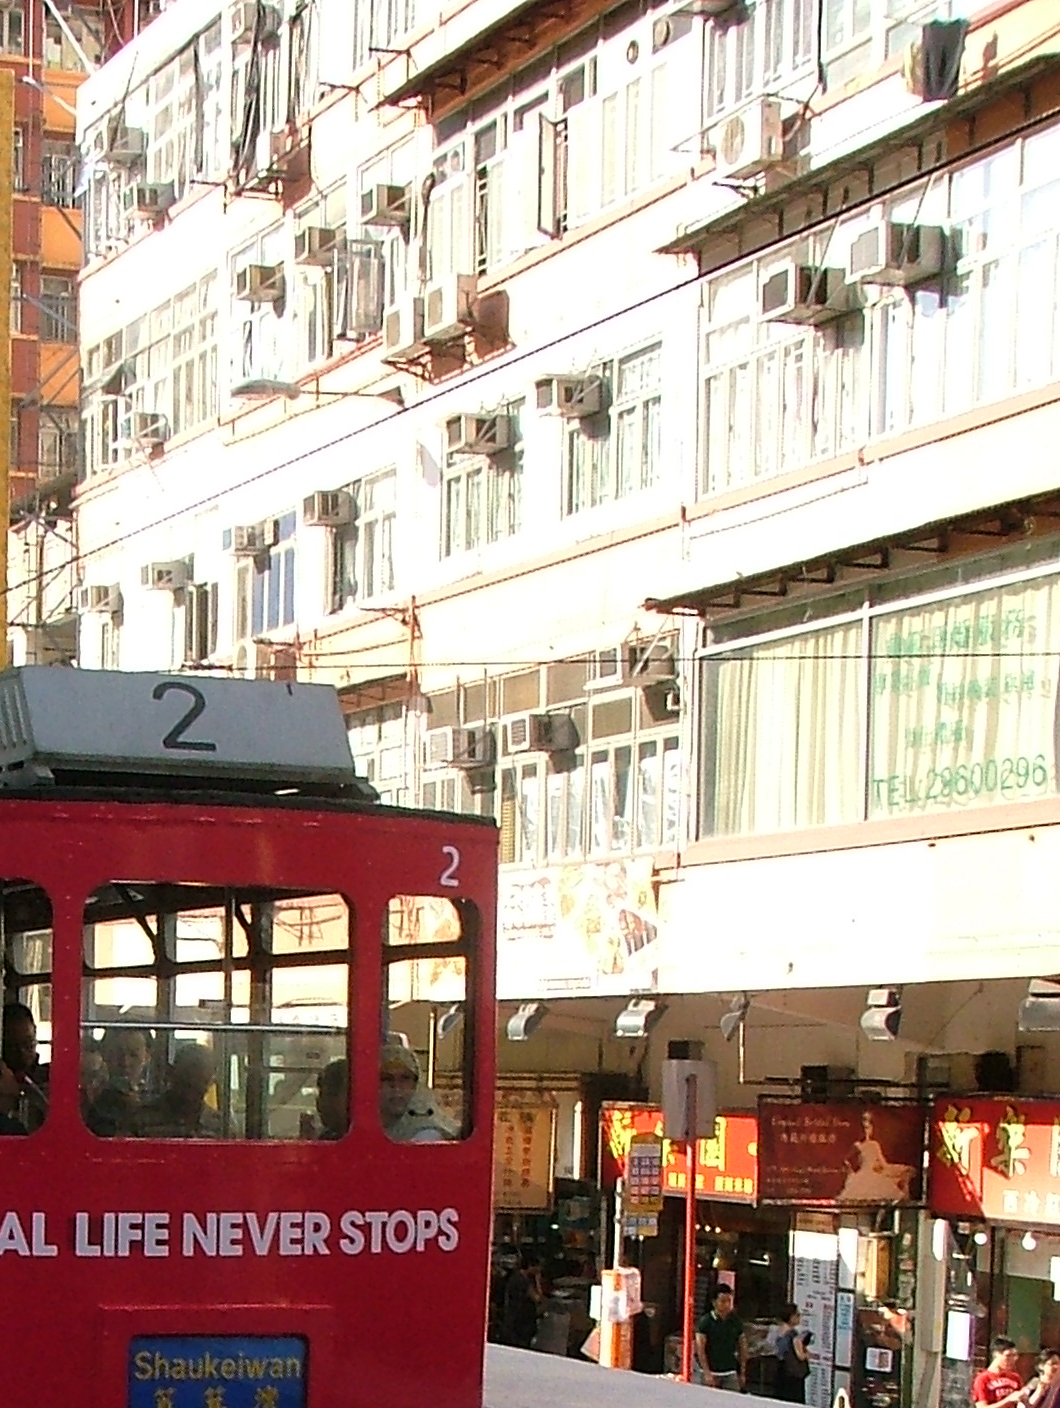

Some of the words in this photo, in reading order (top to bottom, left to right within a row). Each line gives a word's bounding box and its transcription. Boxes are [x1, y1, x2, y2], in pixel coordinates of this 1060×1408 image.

[152, 681, 217, 752] 2
[441, 846, 461, 887] 2
[75, 1212, 170, 1258] LIFE
[182, 1211, 332, 1258] NEVER
[340, 1207, 460, 1255] STOPS
[133, 1350, 302, 1381] Shaukeiwan
